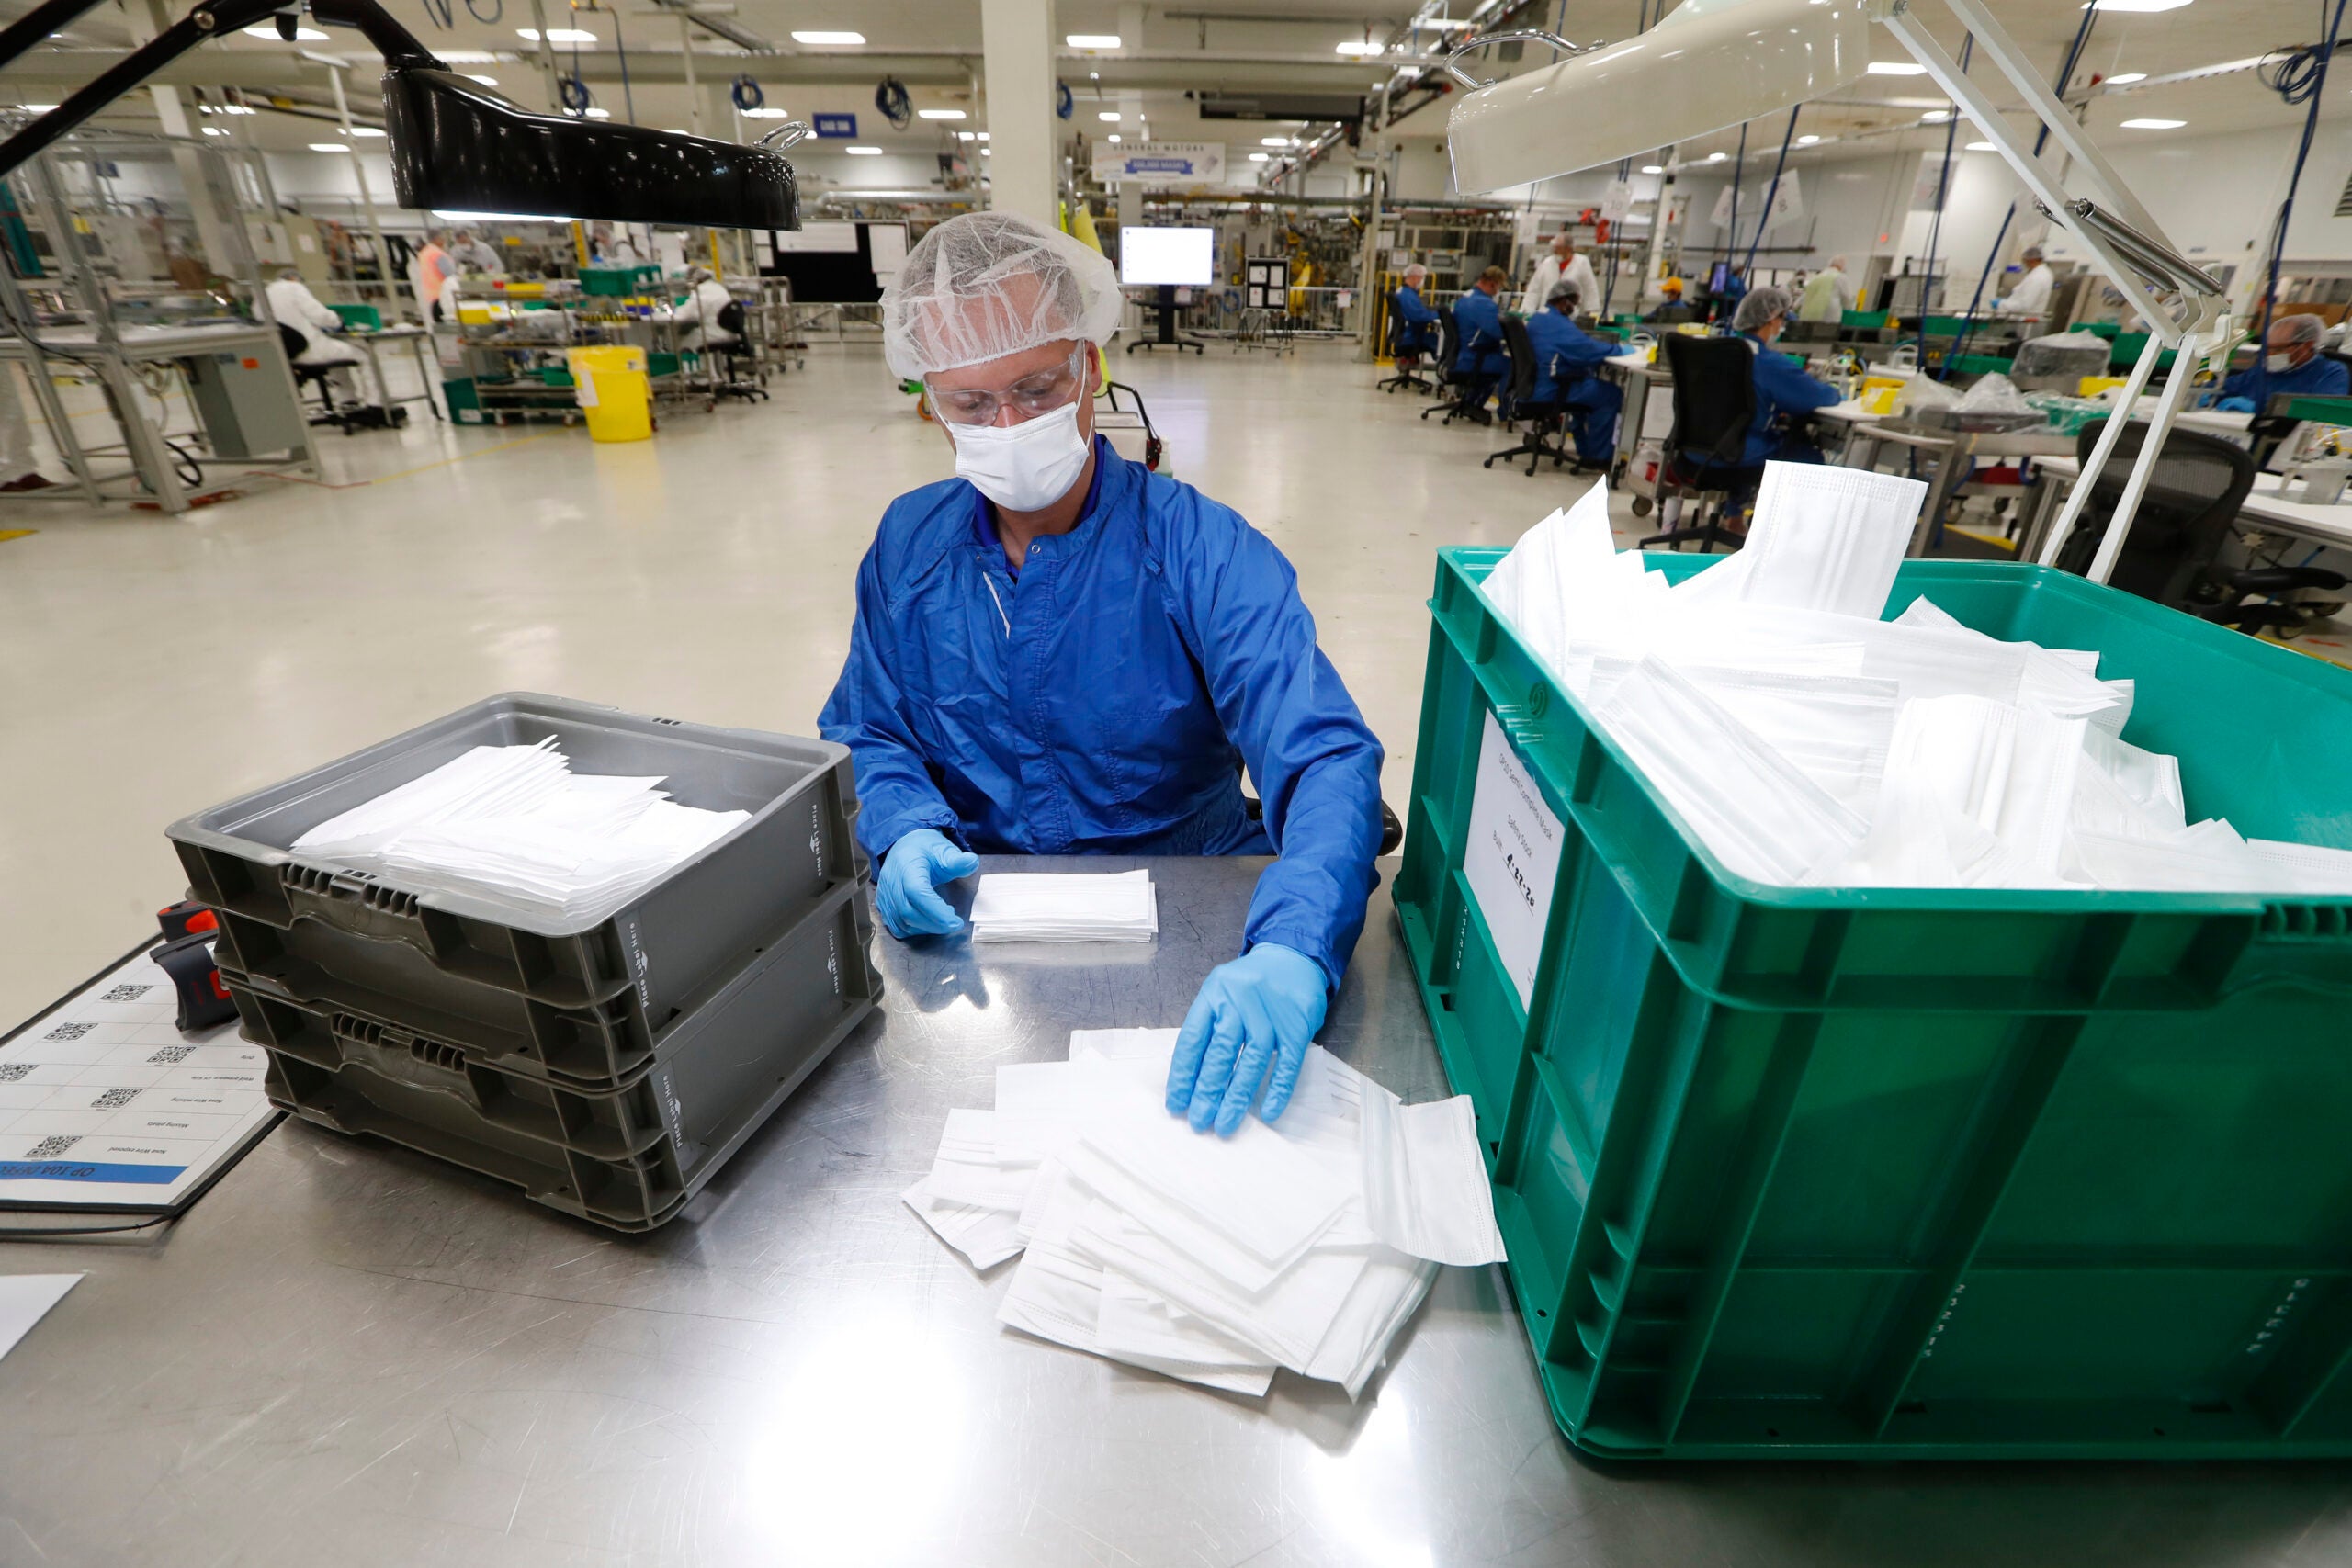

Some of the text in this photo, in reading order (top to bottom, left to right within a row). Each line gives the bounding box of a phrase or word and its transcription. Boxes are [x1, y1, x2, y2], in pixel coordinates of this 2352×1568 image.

[629, 922, 650, 1008] Place Label Here
[662, 1075, 683, 1148] Place Label Here
[70, 1167, 96, 1177] OP
